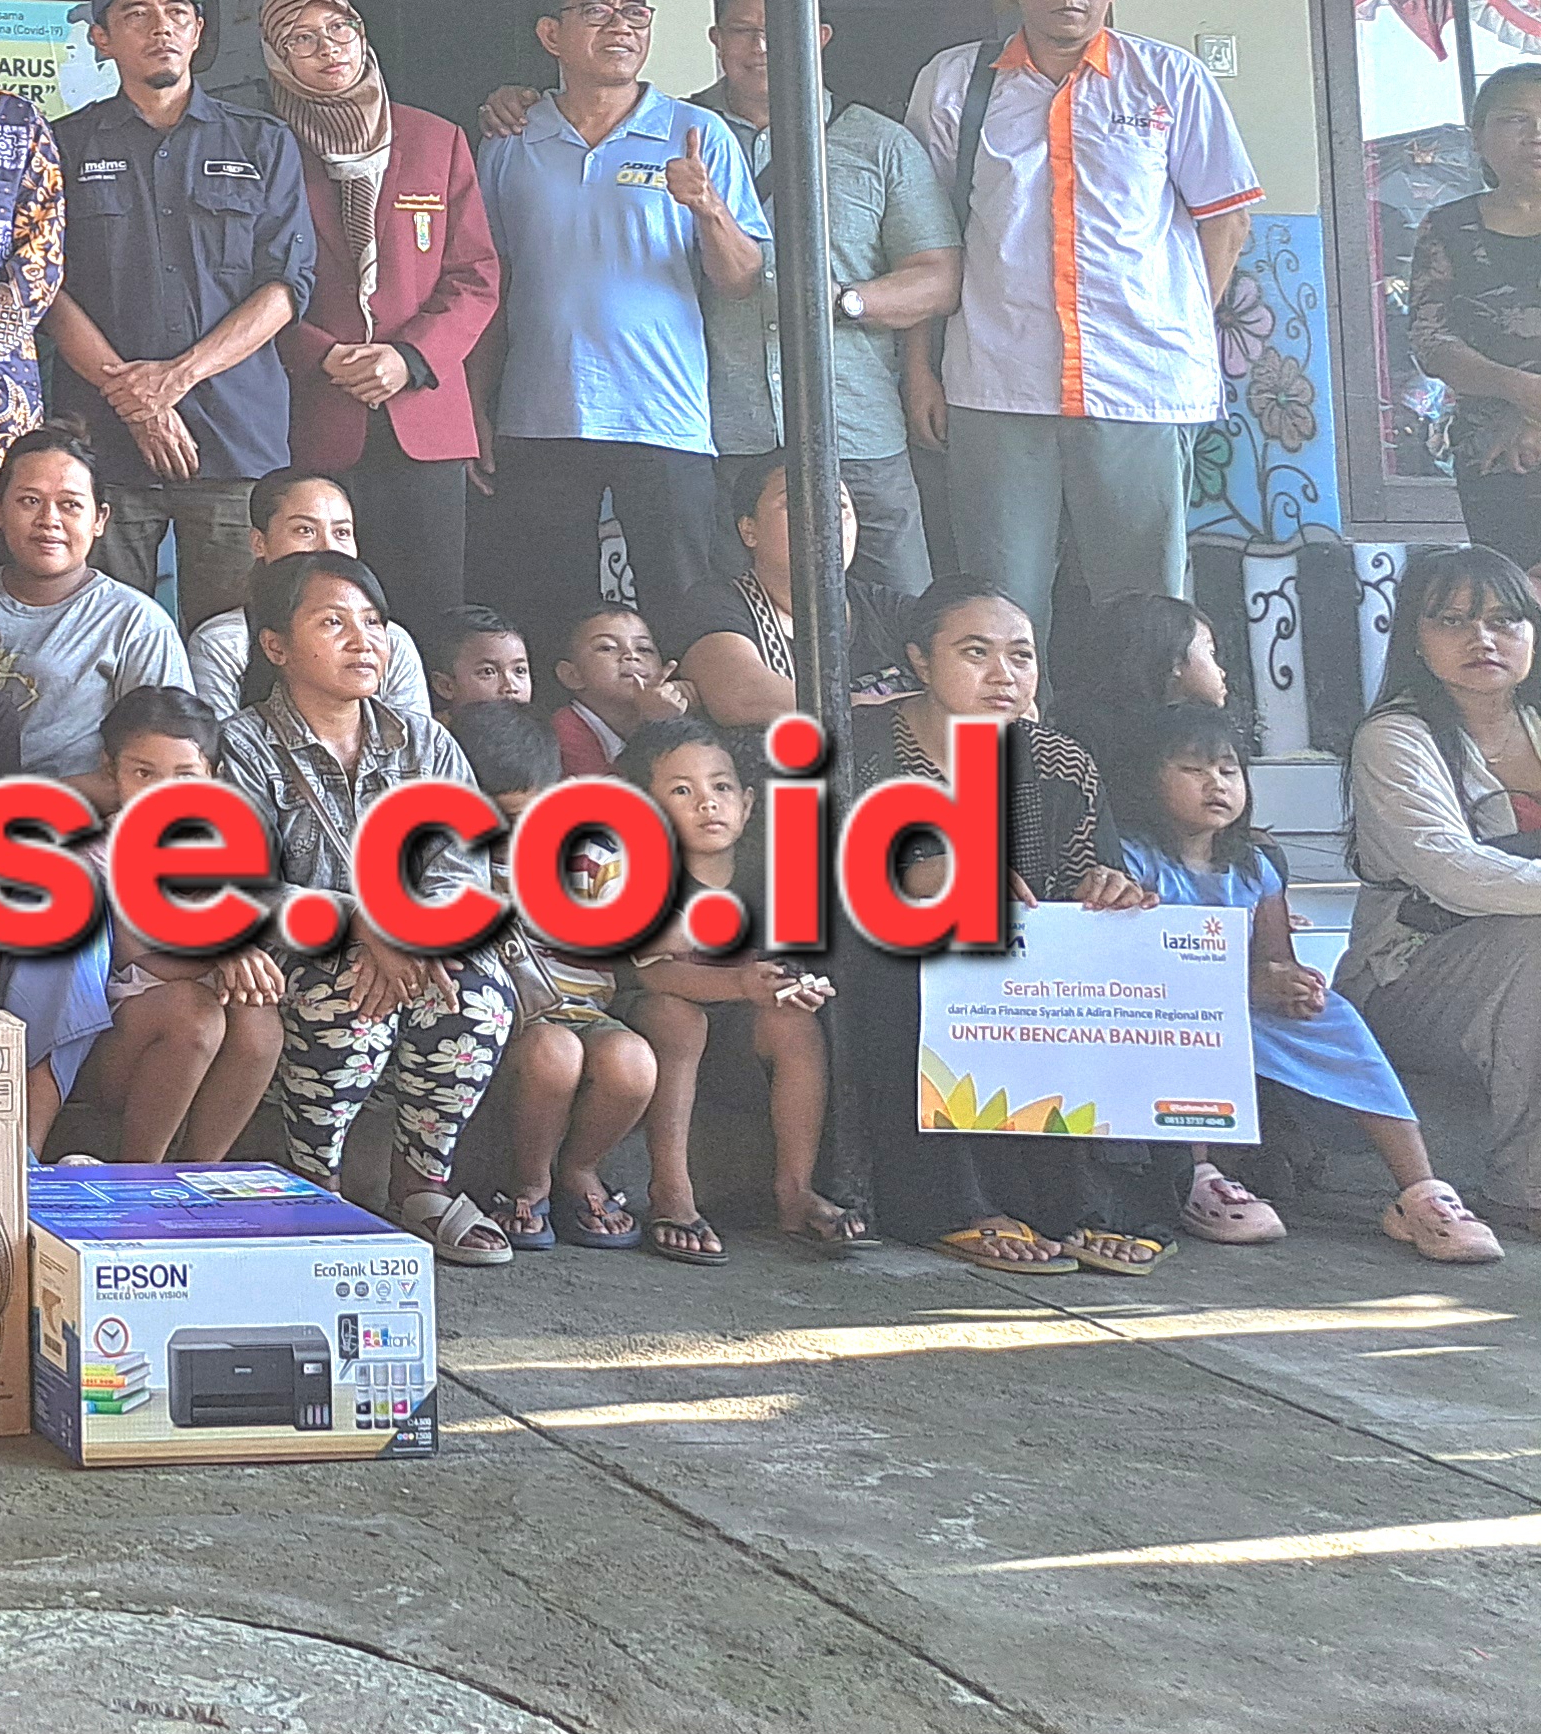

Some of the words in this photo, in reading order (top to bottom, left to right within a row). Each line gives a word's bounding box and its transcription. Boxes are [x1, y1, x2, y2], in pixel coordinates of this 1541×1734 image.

[13, 25, 63, 36] (Covid-19)
[85, 160, 127, 172] mdmc
[1163, 932, 1227, 951] lazismu
[1004, 980, 1050, 998] Serah
[1053, 981, 1106, 998] Terima
[1110, 982, 1167, 1000] Donasi
[948, 1005, 968, 1015] dari
[970, 1005, 996, 1016] Adira
[998, 1006, 1037, 1017] Finance
[1039, 1007, 1075, 1019] Syariah
[1077, 1008, 1084, 1017] &
[1086, 1007, 1111, 1018] Adira
[1113, 1008, 1153, 1019] Finance
[1154, 1009, 1199, 1022] Regional
[1201, 1011, 1224, 1021] BNT
[952, 1025, 1016, 1042] UNTUK
[1019, 1026, 1104, 1044] BENCANA
[1110, 1029, 1176, 1047] BANJIR
[1180, 1031, 1221, 1048] BALI
[96, 1264, 188, 1290] EPSON
[314, 1262, 367, 1278] EcoTank
[370, 1259, 418, 1276] L3210
[97, 1291, 131, 1301] EXCEED
[133, 1290, 157, 1300] YOUR
[159, 1291, 189, 1300] VISION
